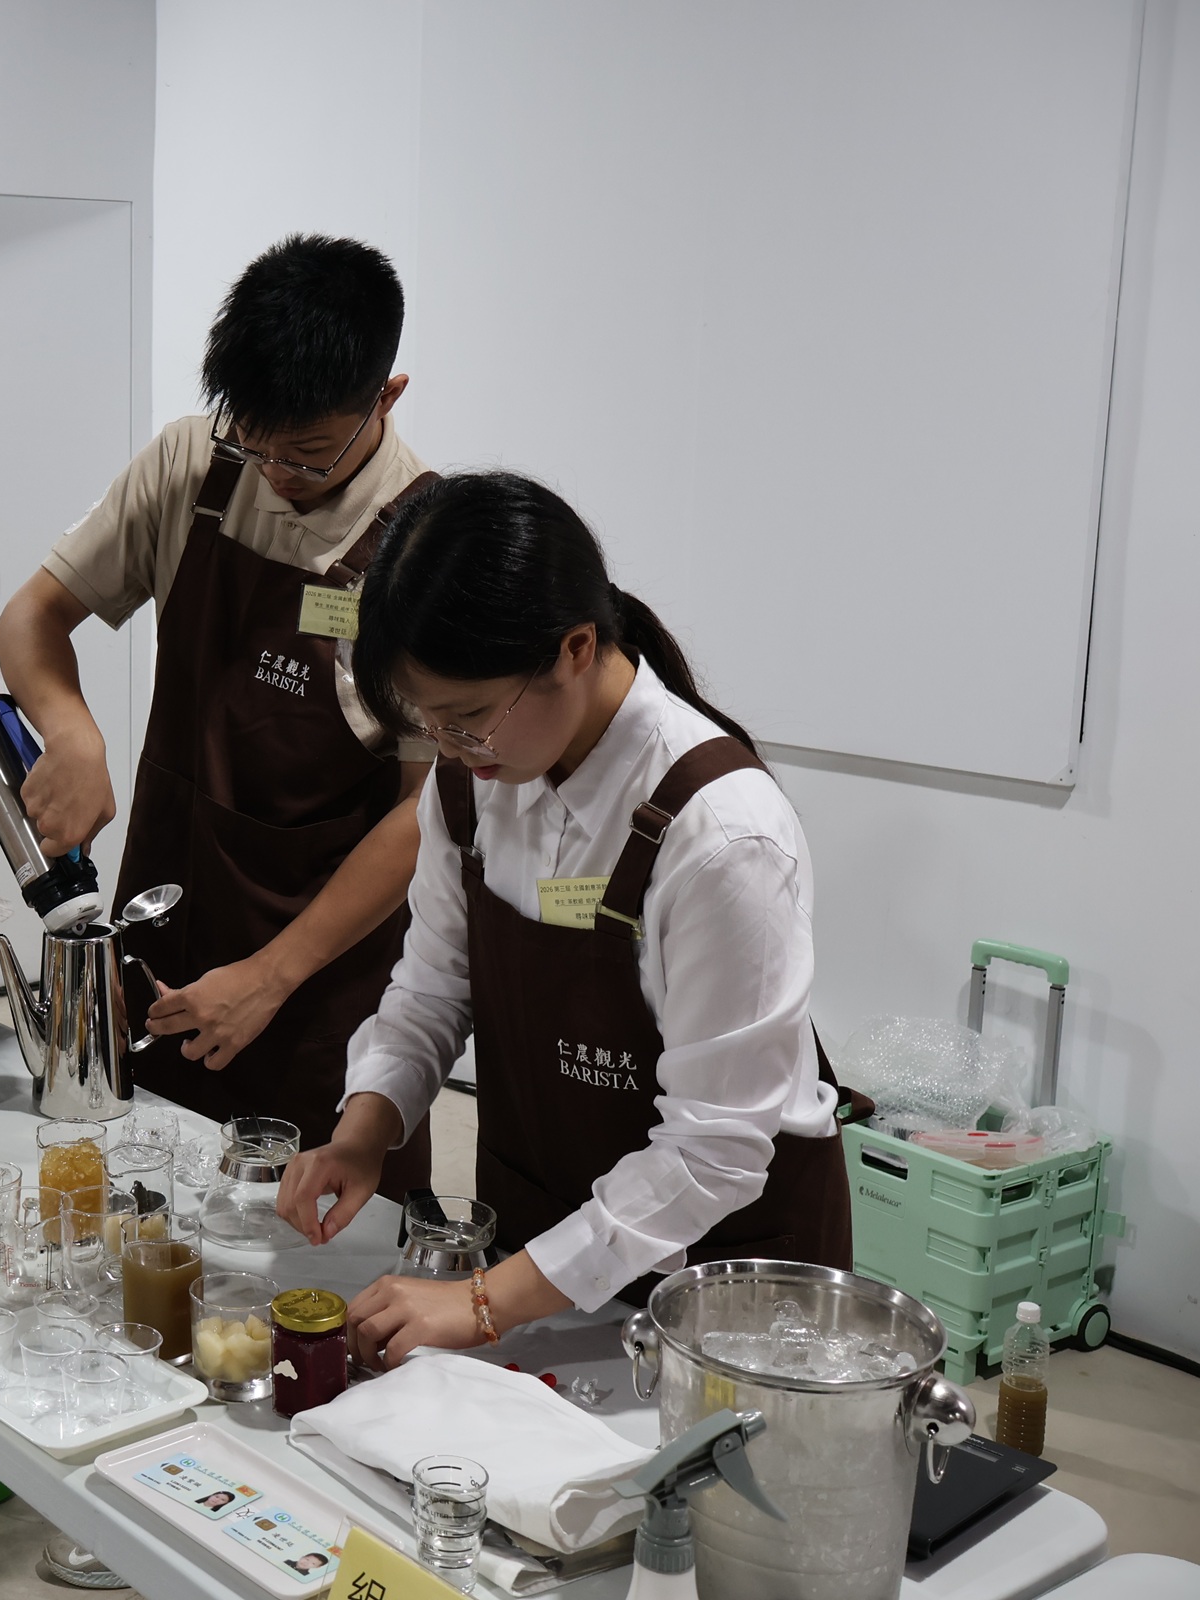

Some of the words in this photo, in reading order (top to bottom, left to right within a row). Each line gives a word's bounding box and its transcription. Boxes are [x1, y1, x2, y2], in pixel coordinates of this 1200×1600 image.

[254, 666, 306, 697] BARISTA
[259, 650, 311, 682] 仁農觀光
[557, 1038, 638, 1071] 仁農觀光
[558, 1058, 640, 1091] BARISTA
[865, 1188, 901, 1208] Melaleuca
